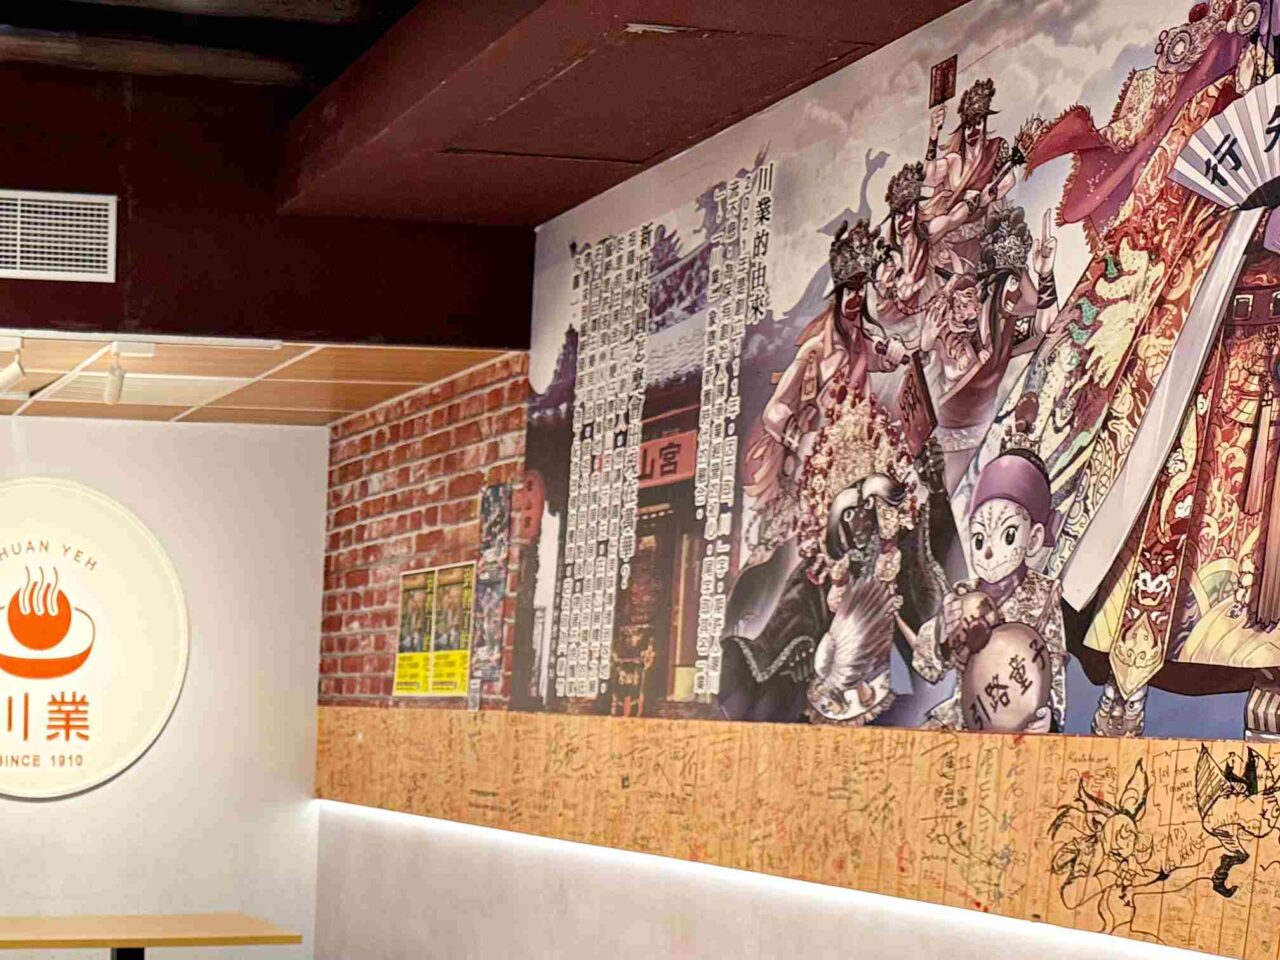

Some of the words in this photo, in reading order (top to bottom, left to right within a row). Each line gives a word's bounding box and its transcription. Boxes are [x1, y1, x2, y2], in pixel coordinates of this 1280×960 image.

[746, 161, 774, 325] 川業的由來
[62, 544, 98, 572] YEH
[51, 754, 83, 768] 1910
